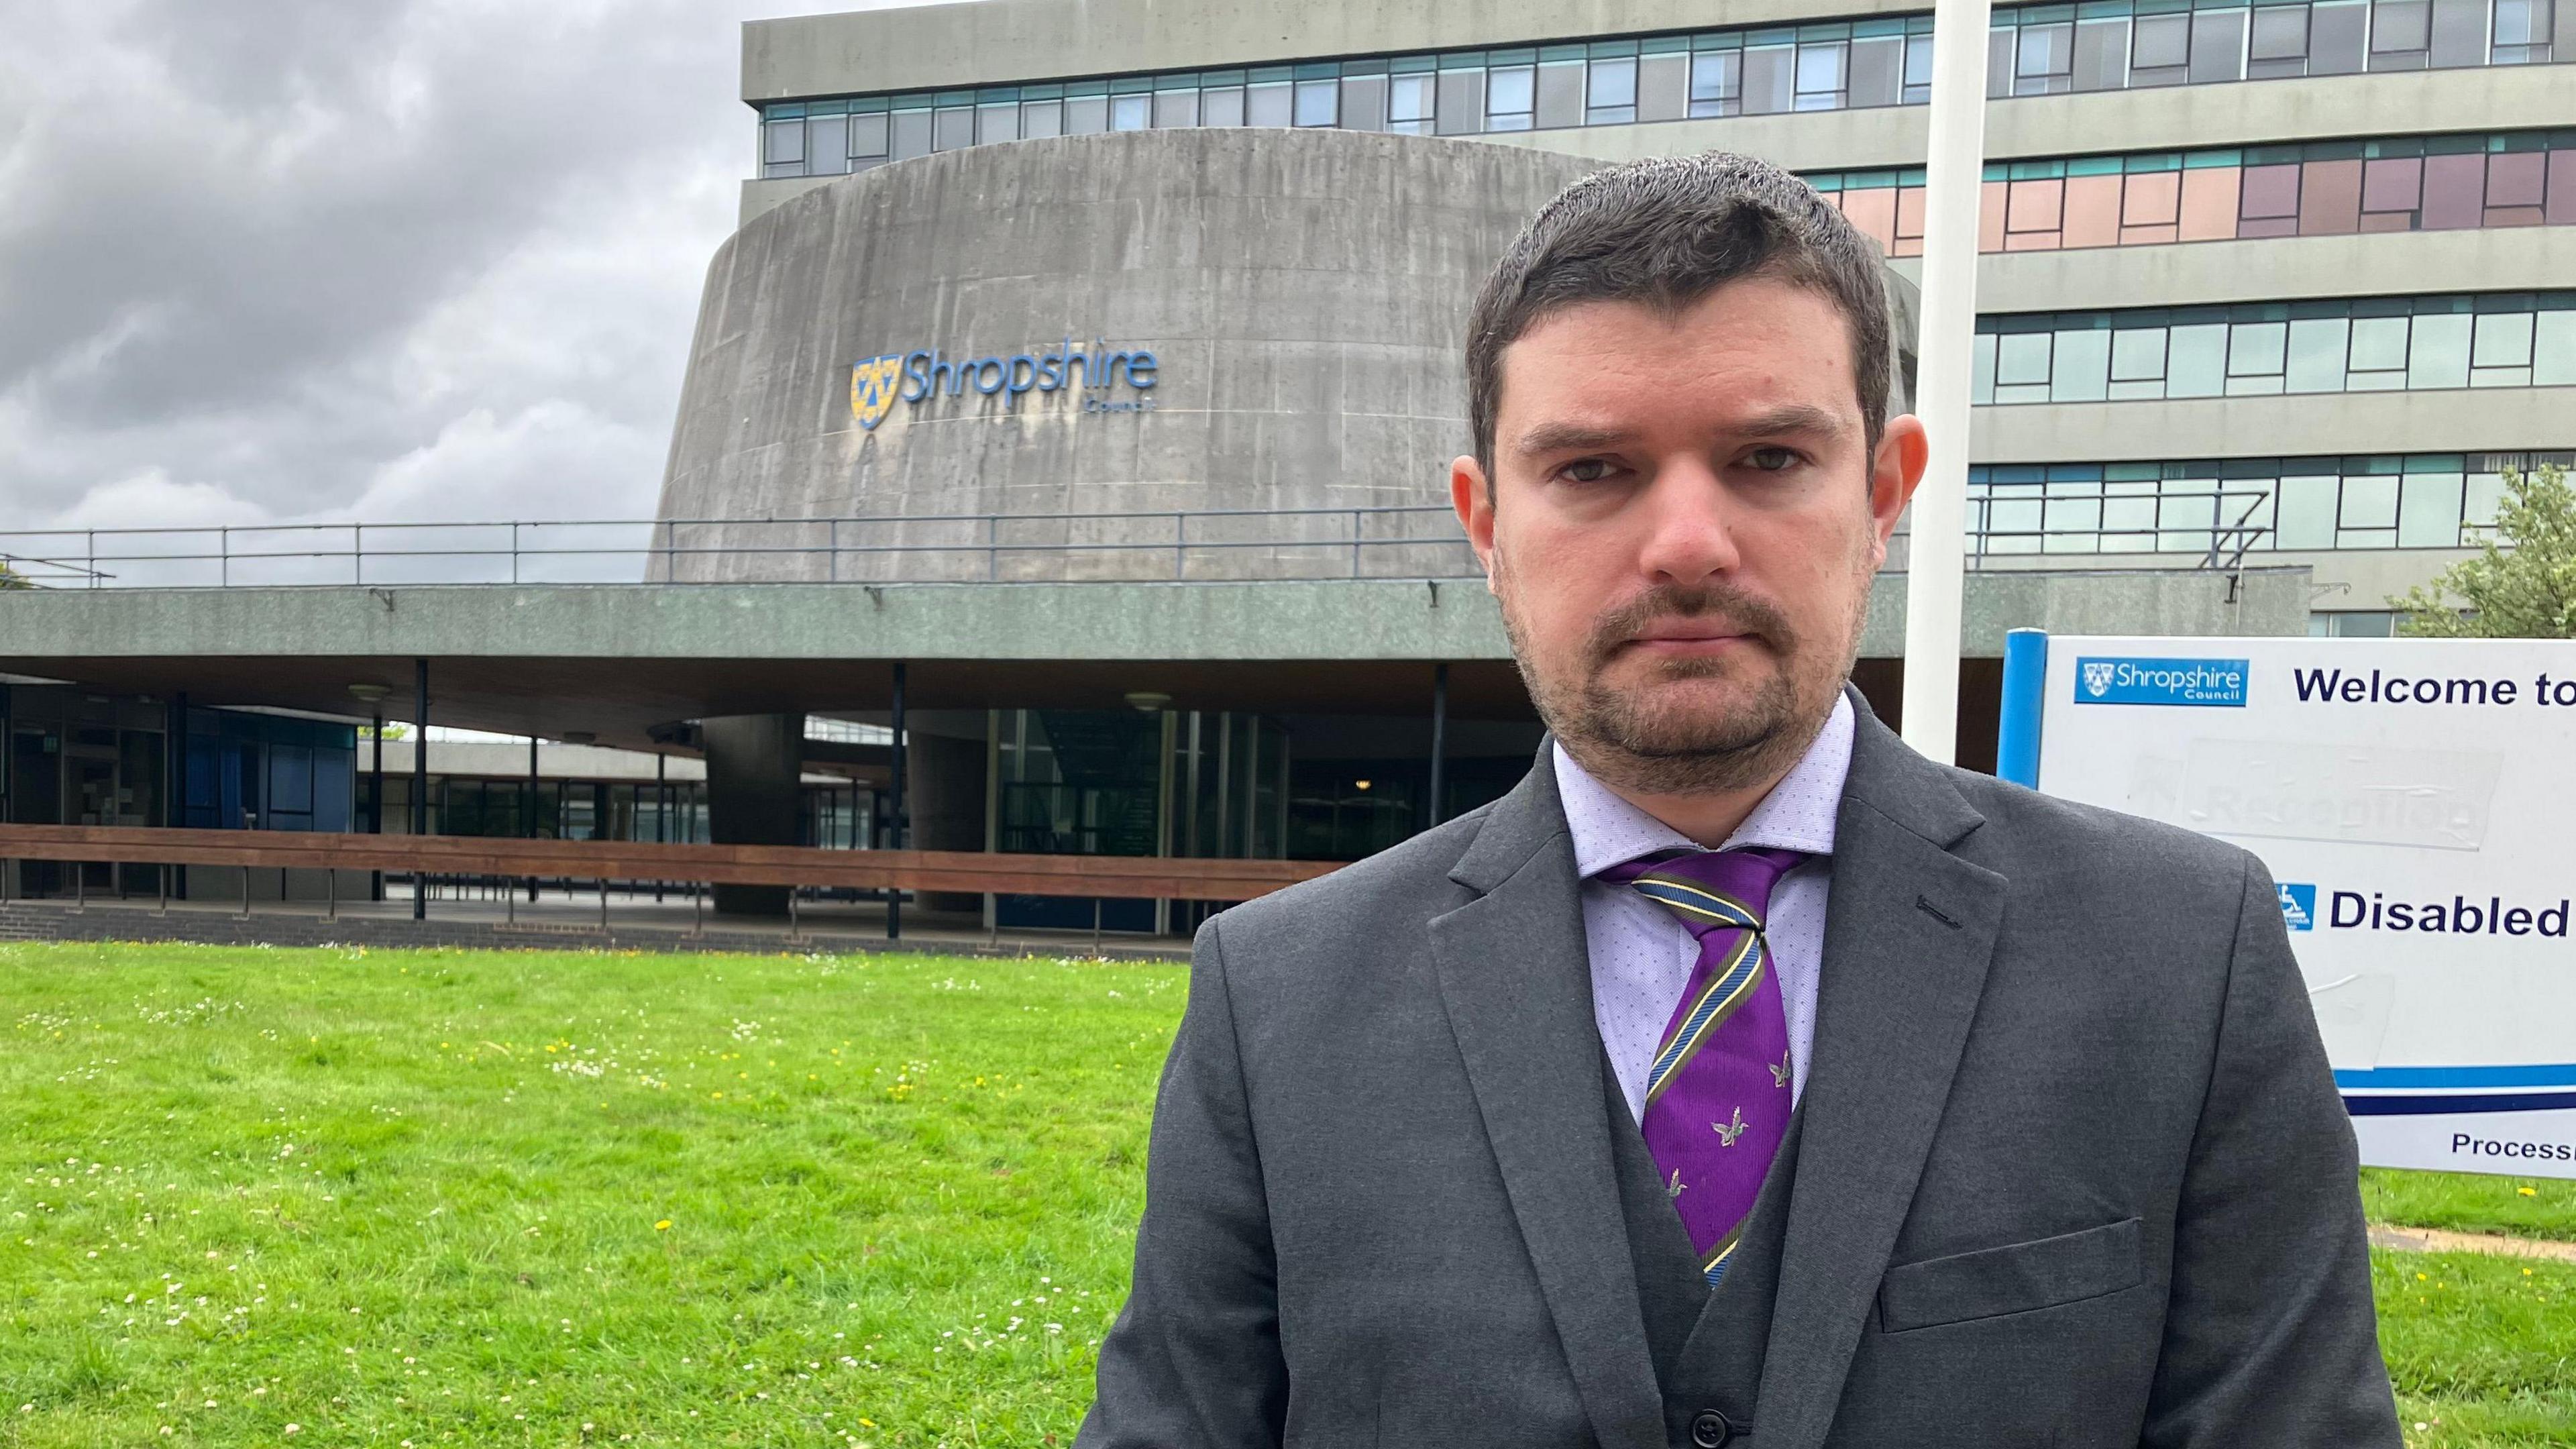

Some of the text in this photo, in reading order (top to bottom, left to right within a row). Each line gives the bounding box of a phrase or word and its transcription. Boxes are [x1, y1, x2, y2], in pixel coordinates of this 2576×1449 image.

[902, 336, 1158, 408] Shropshire
[2116, 663, 2241, 694] Shropshire
[2184, 688, 2240, 700] Council
[2294, 667, 2576, 706] Welcome to
[2330, 890, 2570, 937] Disabled
